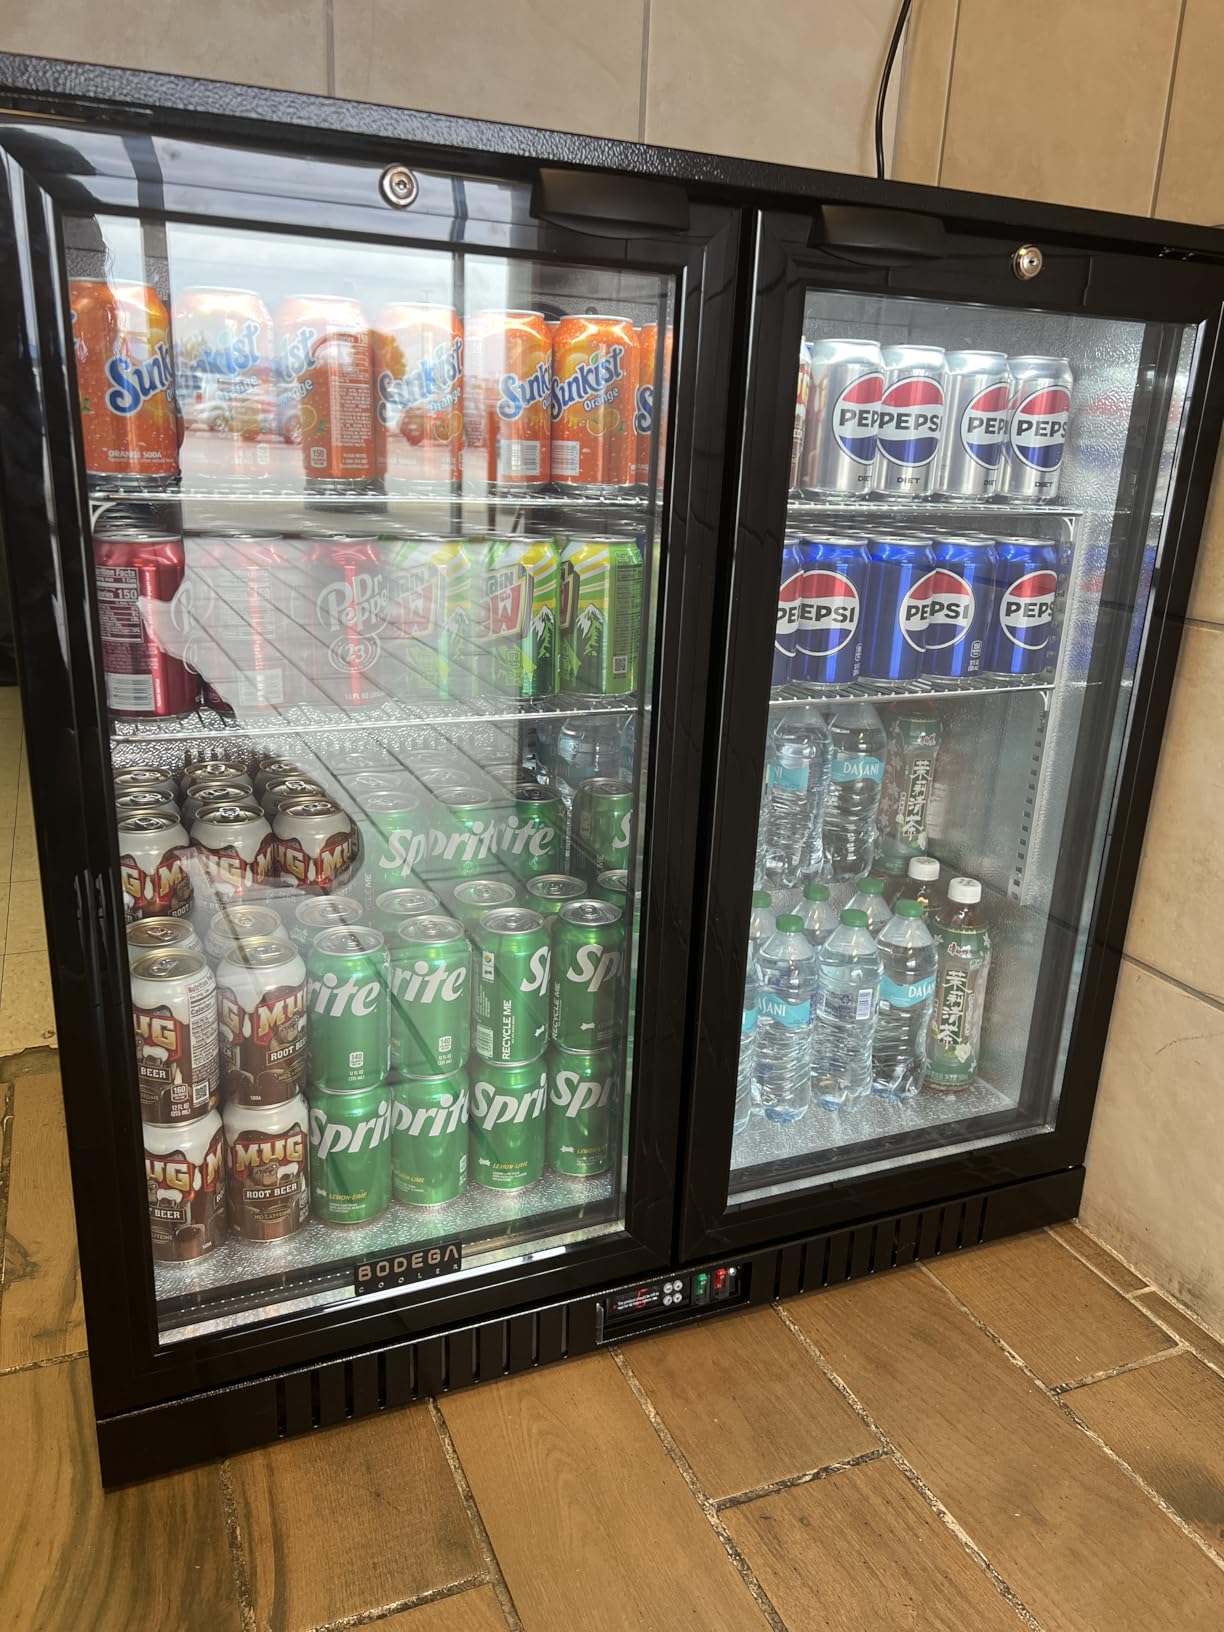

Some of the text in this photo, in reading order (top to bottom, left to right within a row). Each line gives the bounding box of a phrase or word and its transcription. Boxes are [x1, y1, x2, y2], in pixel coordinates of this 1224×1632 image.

[377, 337, 463, 426] Sunkist
[551, 344, 624, 422] Sunkist
[583, 386, 619, 412] Orange
[143, 450, 162, 459] SODA
[896, 476, 920, 484] DIET
[117, 589, 138, 600] 150
[843, 761, 880, 777] DASANI
[937, 970, 973, 1050] 茉莉清茶
[502, 1000, 512, 1060] RECYCLE ME
[270, 1045, 295, 1061] ROOT
[140, 1066, 167, 1079] BEER
[173, 1085, 186, 1094] 160
[235, 1134, 304, 1171] MUG
[246, 1182, 298, 1200] ROOT BEER
[154, 1209, 181, 1219] BEER
[358, 1245, 459, 1282] BODEGA
